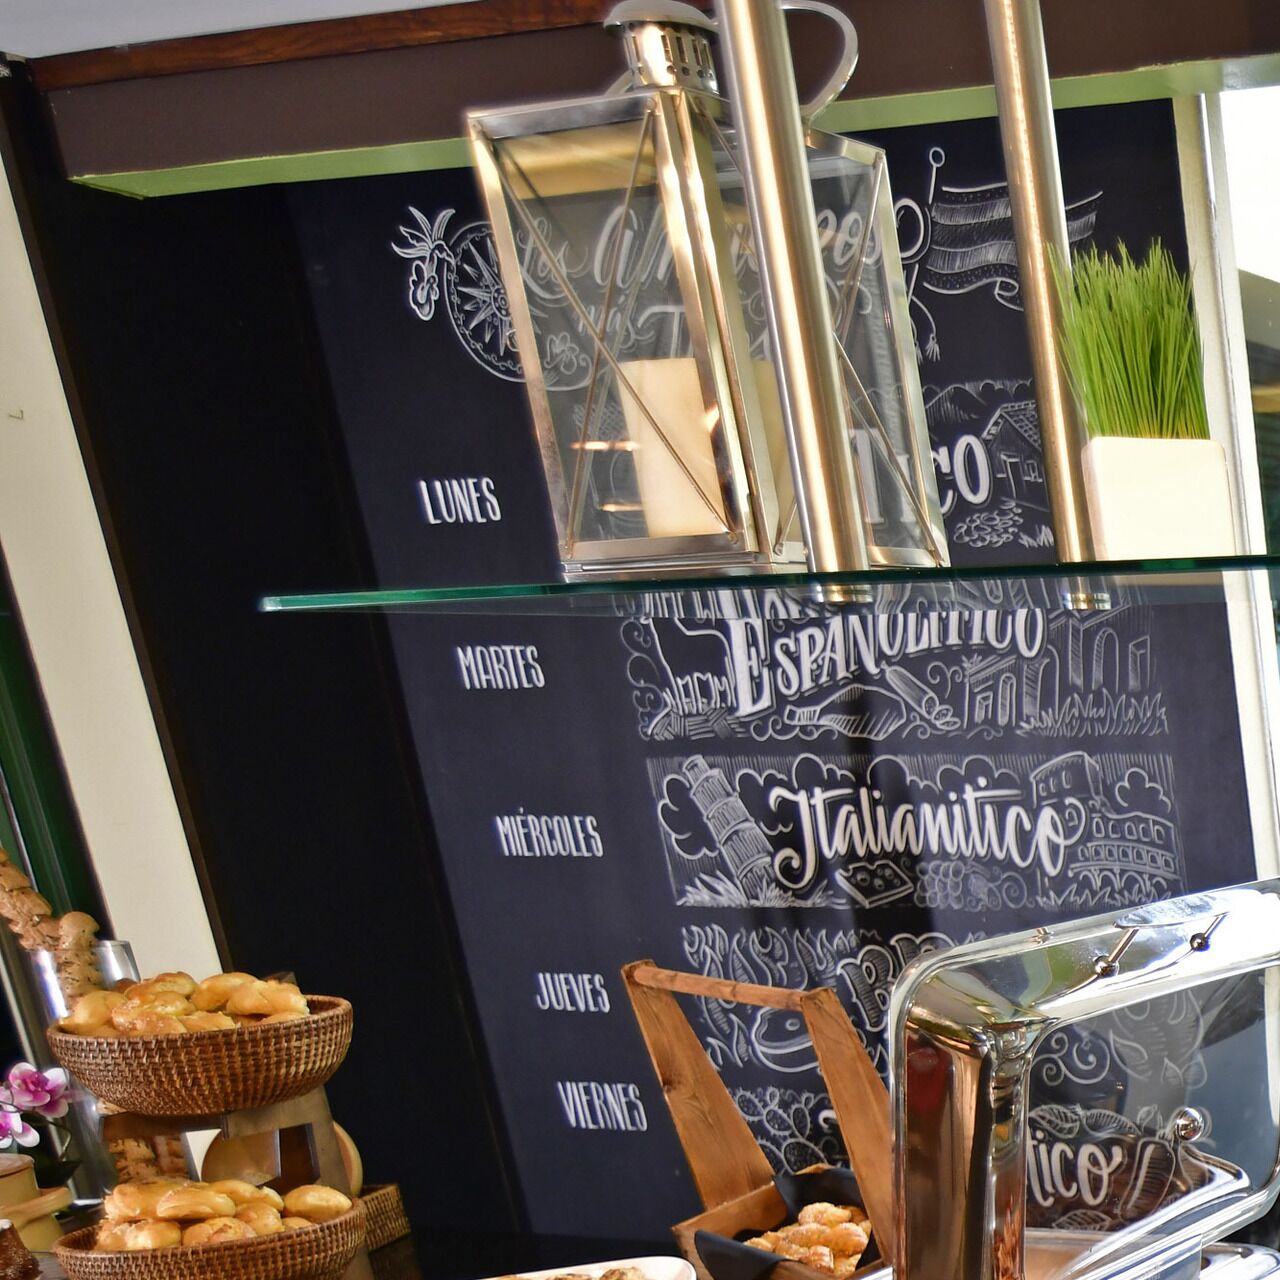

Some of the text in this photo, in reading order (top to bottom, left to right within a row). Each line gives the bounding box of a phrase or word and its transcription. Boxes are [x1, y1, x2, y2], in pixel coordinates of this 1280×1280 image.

[418, 477, 502, 525] LUNES
[456, 645, 546, 690] MARTES
[495, 807, 604, 858] MIÉRCOLES
[536, 972, 611, 1013] JUEVES
[557, 1081, 649, 1132] VIERNES
